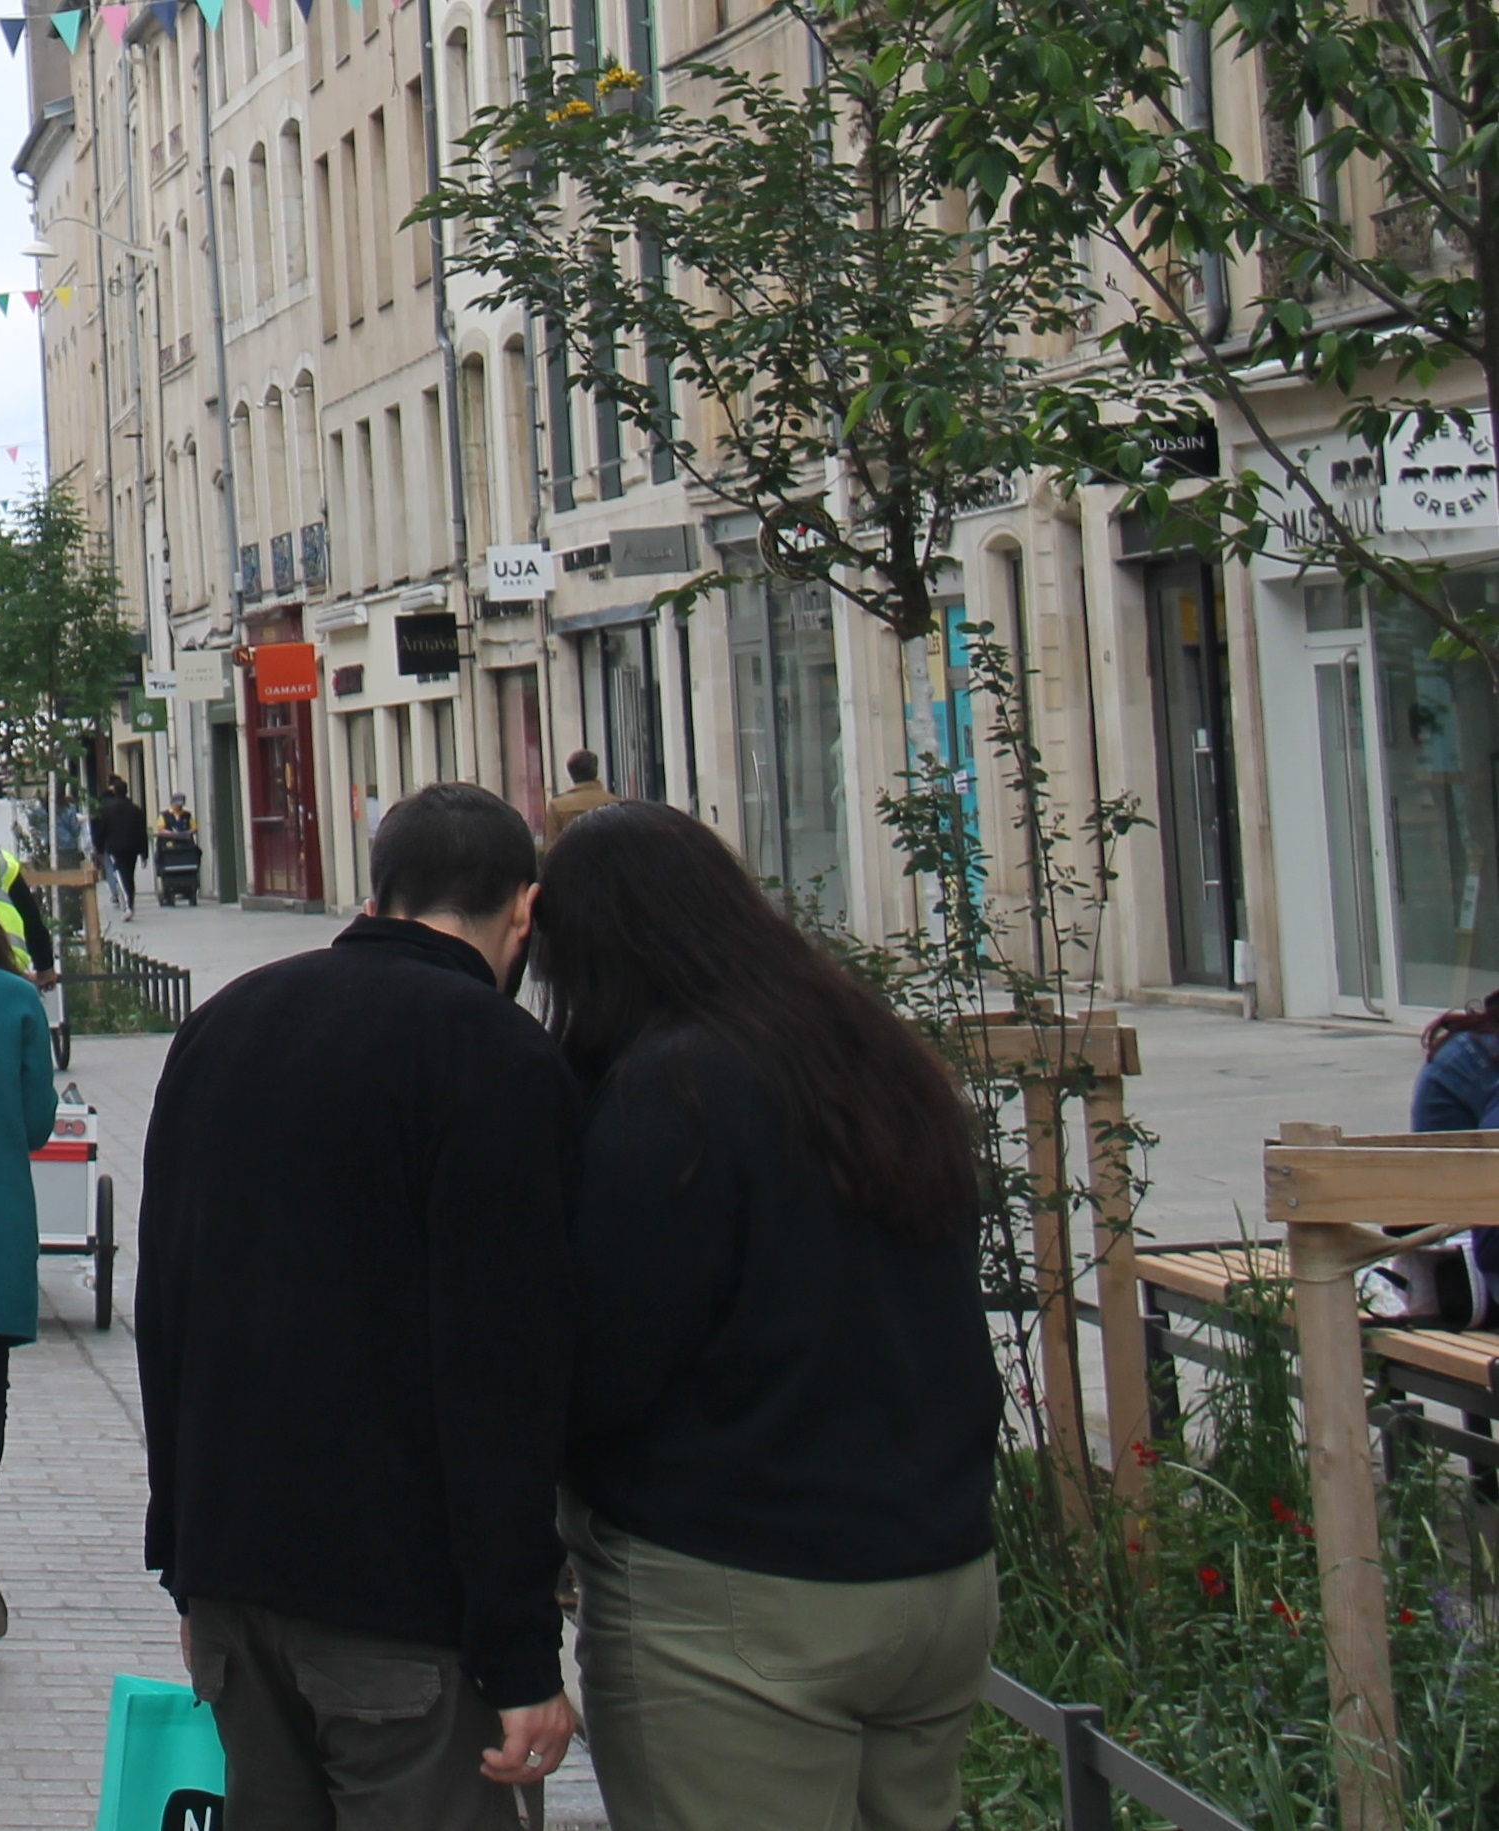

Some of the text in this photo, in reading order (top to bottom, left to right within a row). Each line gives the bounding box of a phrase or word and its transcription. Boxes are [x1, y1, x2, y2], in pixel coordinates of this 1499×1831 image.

[1149, 435, 1206, 452] USSIN
[1461, 426, 1490, 455] AU
[1413, 487, 1487, 517] GREEN
[493, 560, 539, 578] UJA
